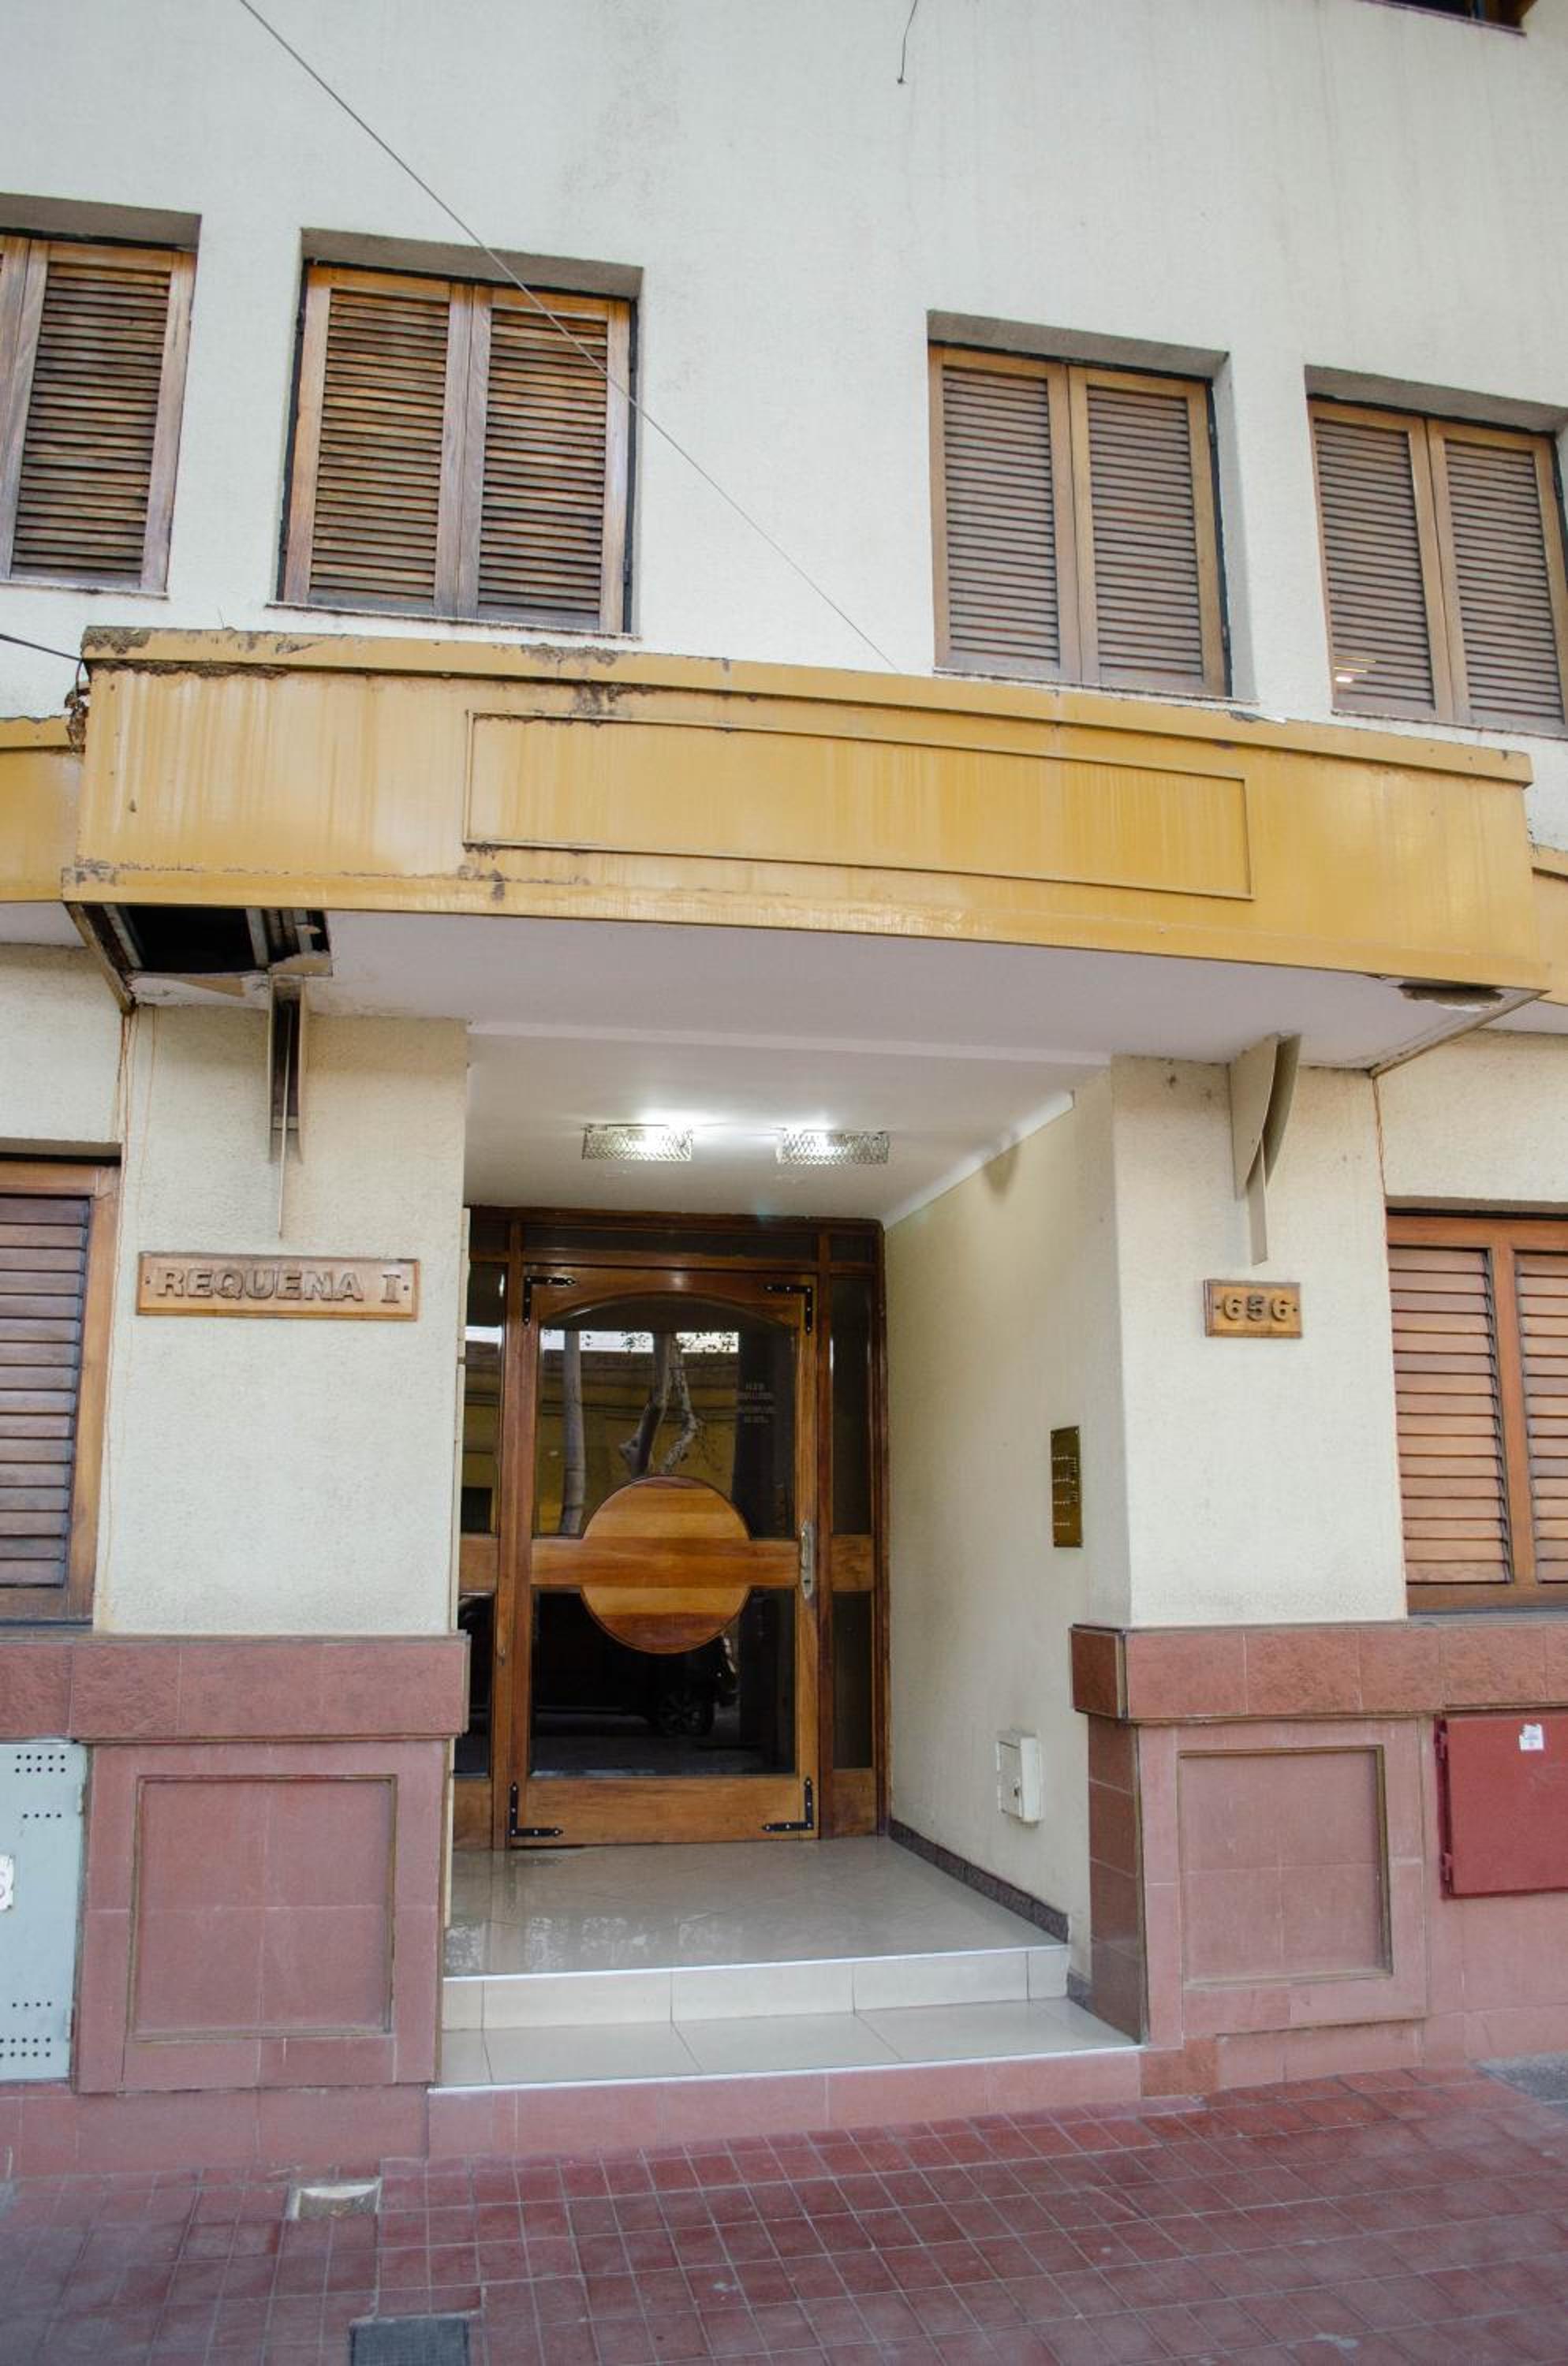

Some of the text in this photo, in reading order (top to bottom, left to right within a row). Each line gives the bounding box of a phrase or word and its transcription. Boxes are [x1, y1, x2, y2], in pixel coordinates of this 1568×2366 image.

[156, 1266, 401, 1303] REQUENA I
[1223, 1295, 1290, 1322] 656
